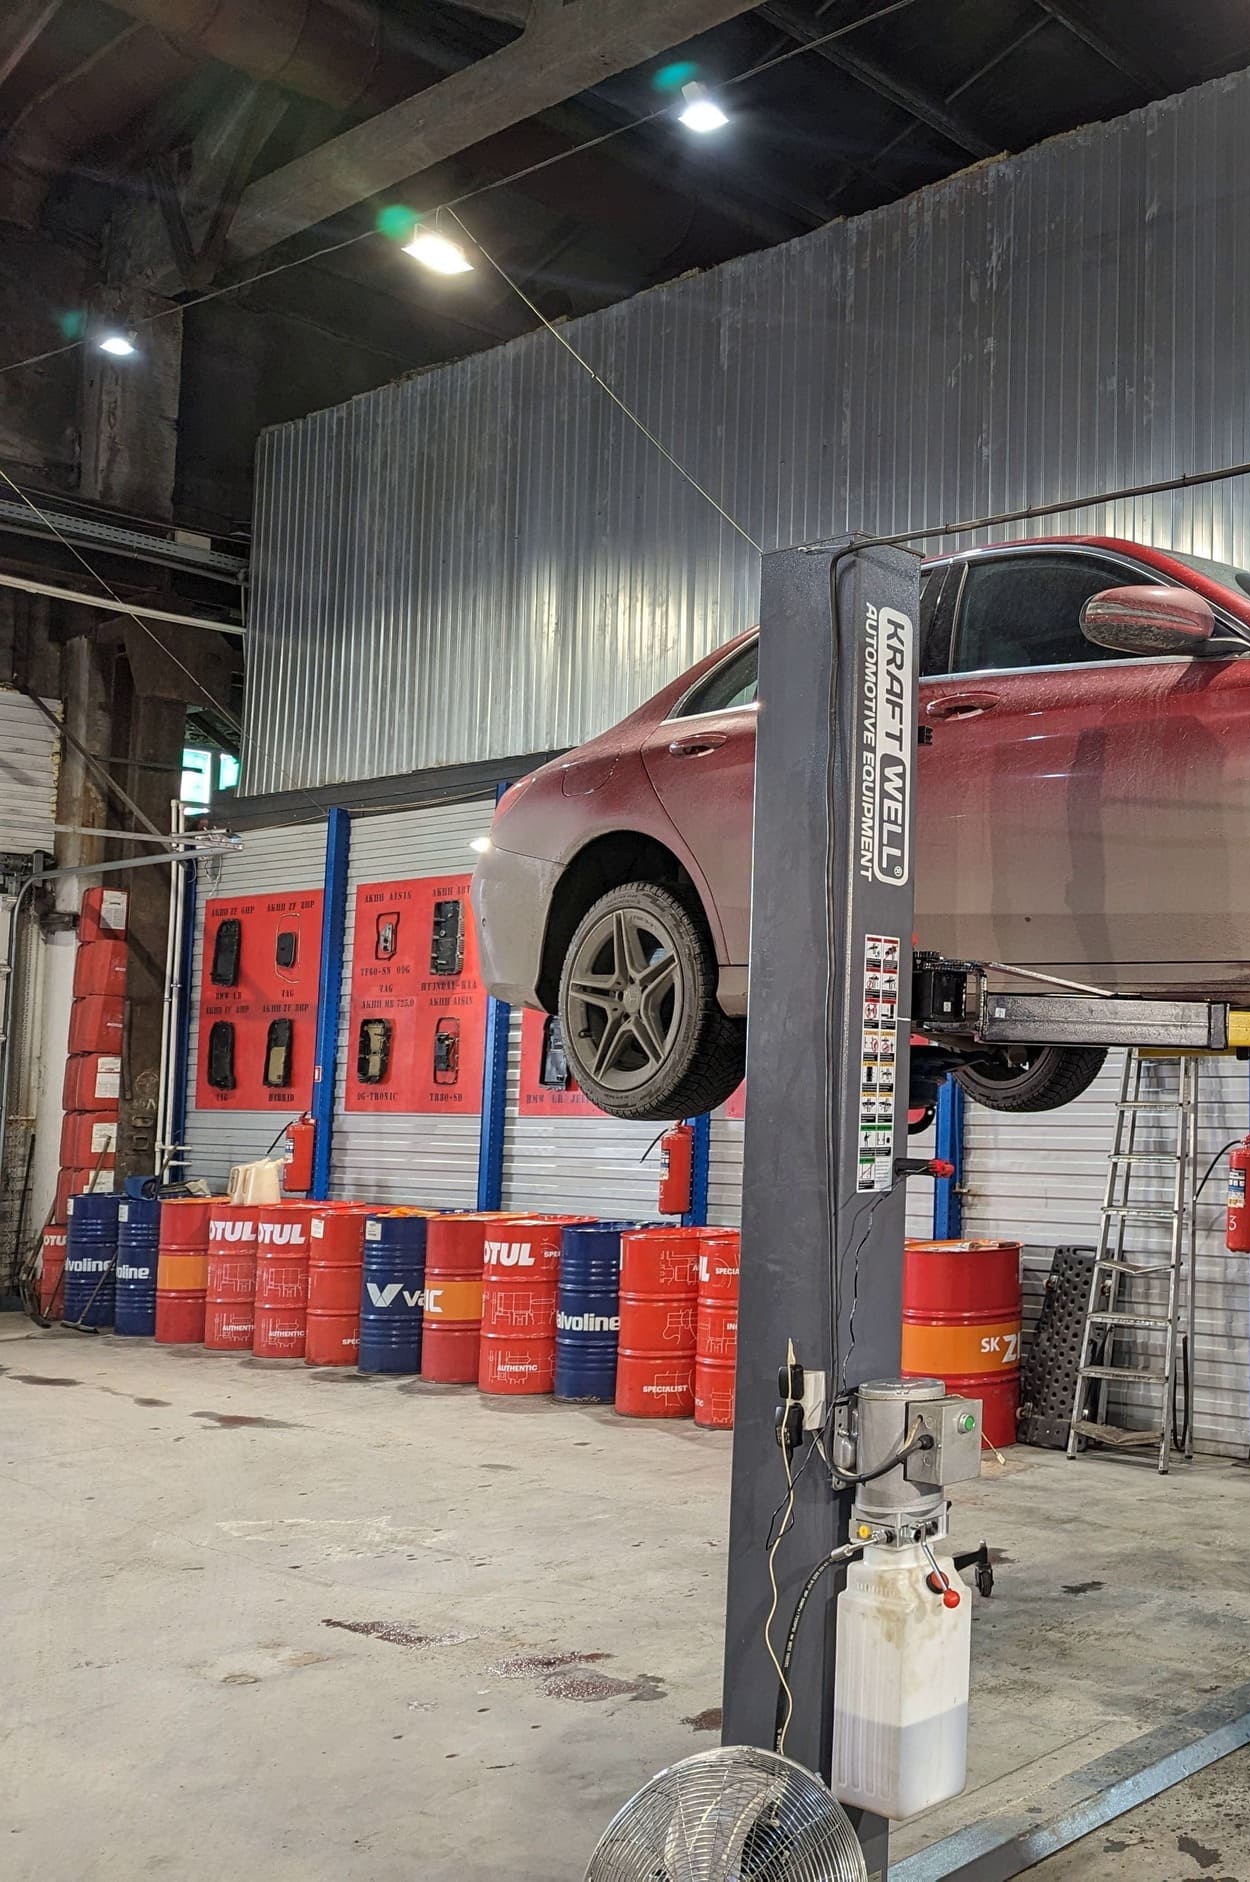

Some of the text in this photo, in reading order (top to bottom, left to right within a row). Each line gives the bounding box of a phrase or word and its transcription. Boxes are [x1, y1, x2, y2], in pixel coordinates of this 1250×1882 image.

[859, 601, 878, 882] AUTOMOTIVE EQUIPMENT
[882, 618, 905, 869] KRAFT WELL
[1228, 1215, 1237, 1231] 3
[981, 1336, 1001, 1353] SK
[642, 1384, 689, 1393] SPECIALIST
